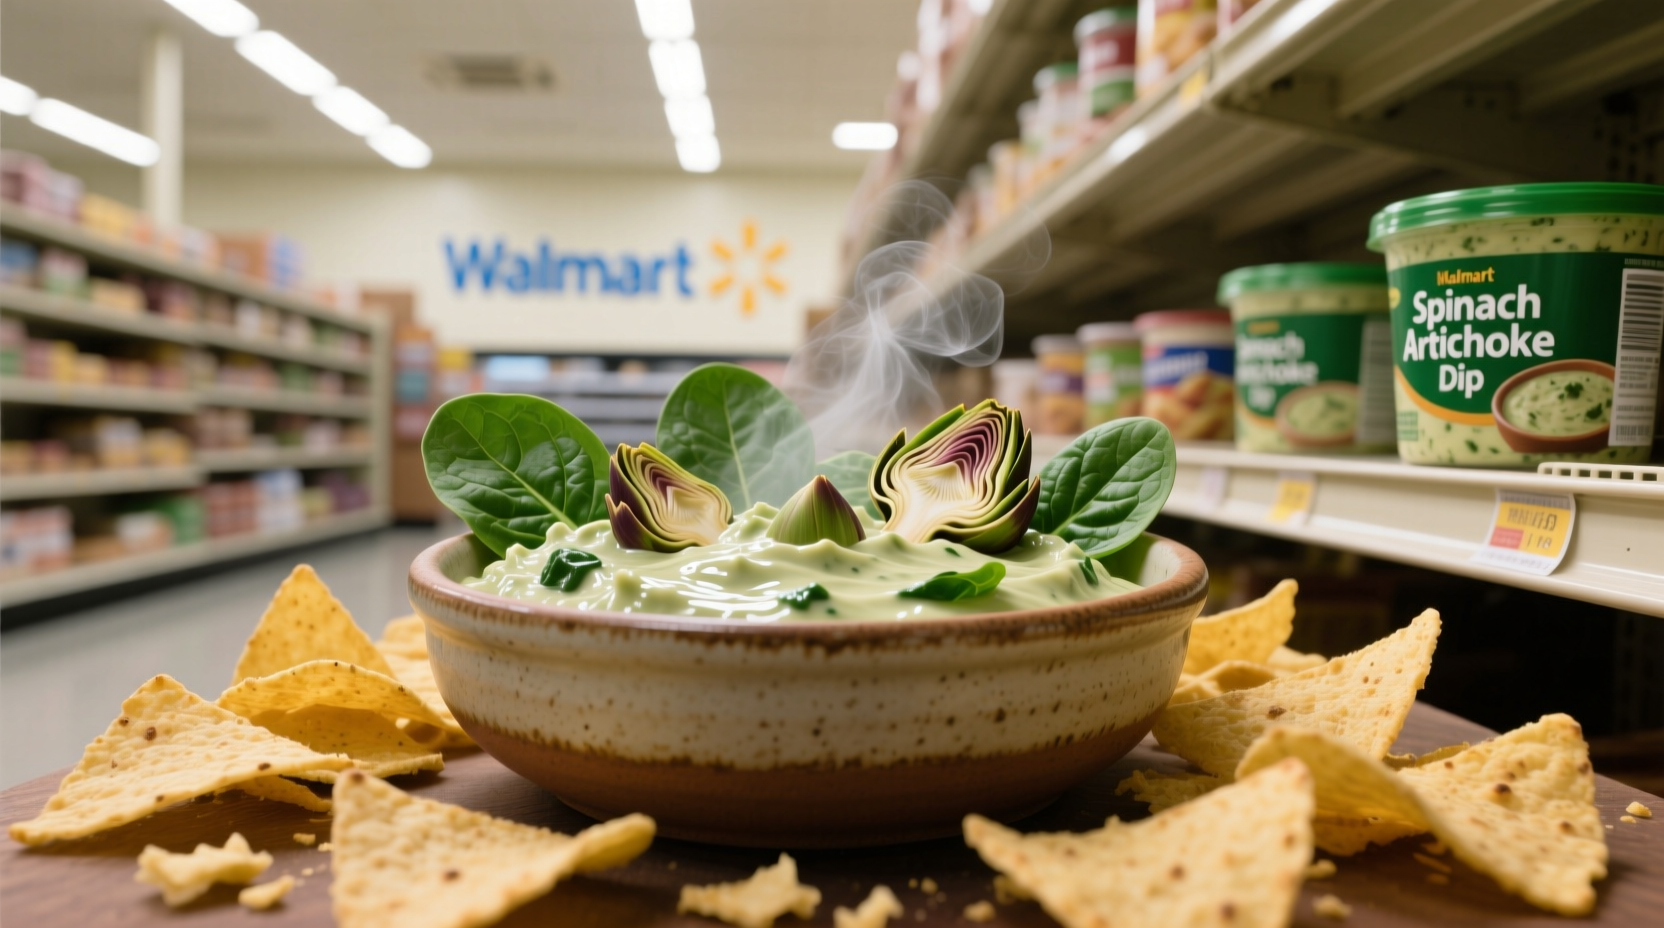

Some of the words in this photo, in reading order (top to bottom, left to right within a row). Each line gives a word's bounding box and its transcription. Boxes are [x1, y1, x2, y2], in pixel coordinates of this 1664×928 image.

[443, 237, 693, 297] Walmart
[1412, 283, 1541, 331] Spinach
[1402, 322, 1555, 362] Artichoke
[1439, 362, 1485, 399] Dip
